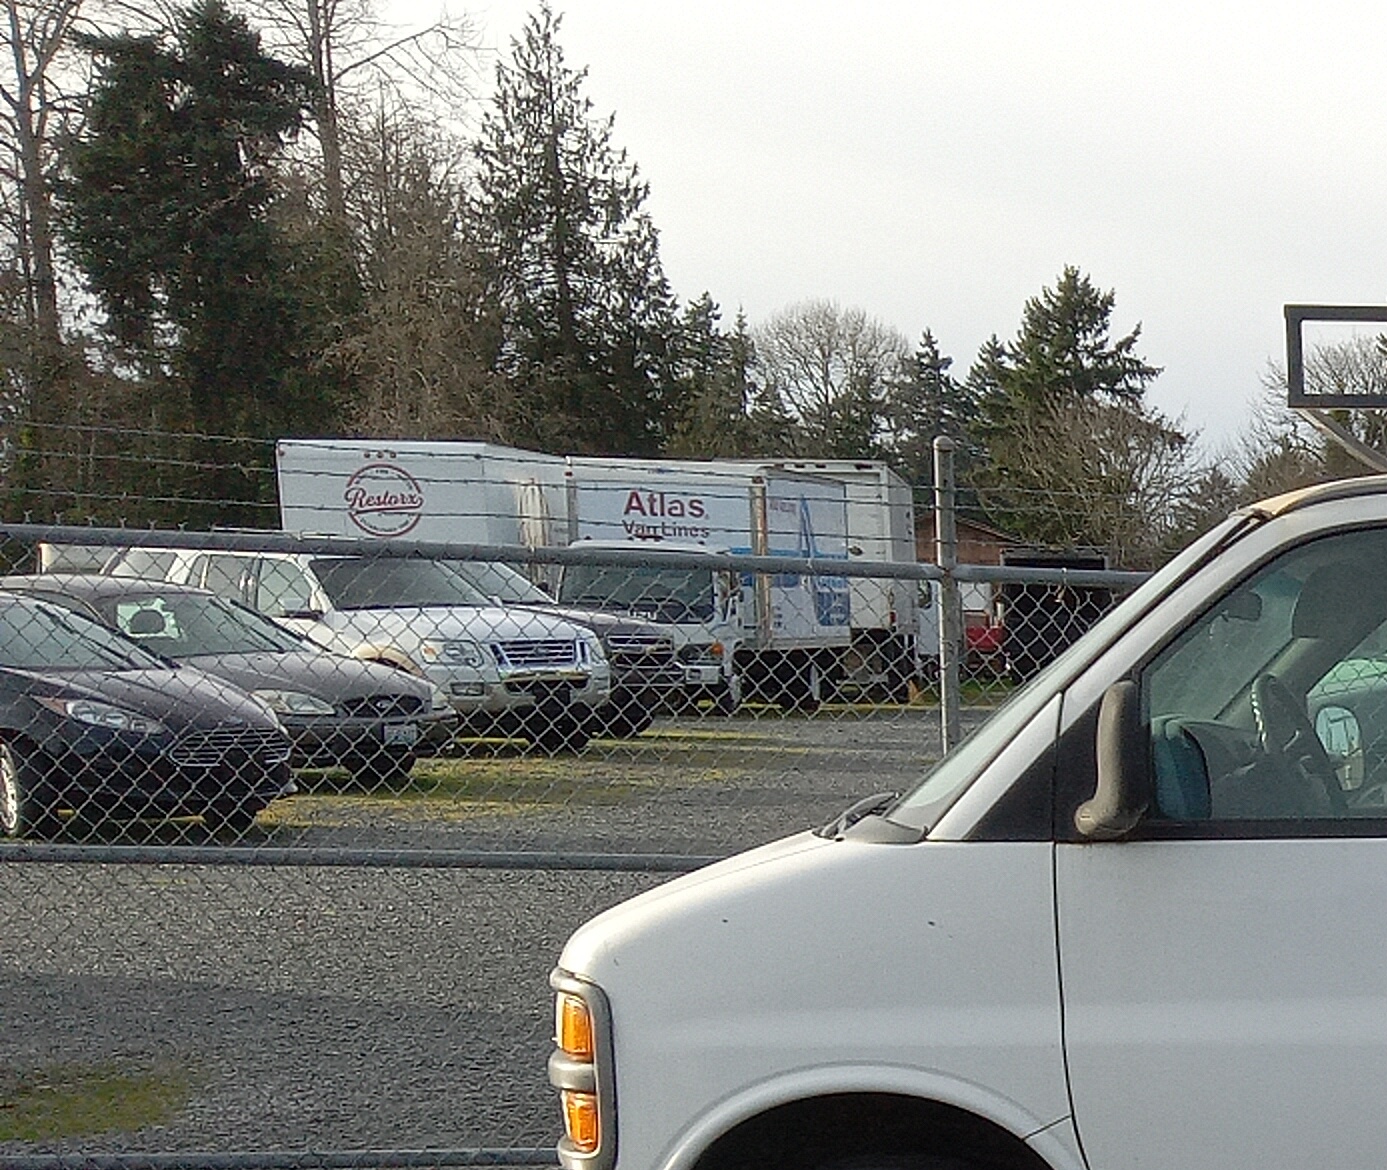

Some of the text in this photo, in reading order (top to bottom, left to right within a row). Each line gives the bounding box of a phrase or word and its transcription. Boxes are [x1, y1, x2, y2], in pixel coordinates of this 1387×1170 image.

[624, 490, 705, 517] Atlas
[622, 520, 710, 538] Van Lines
